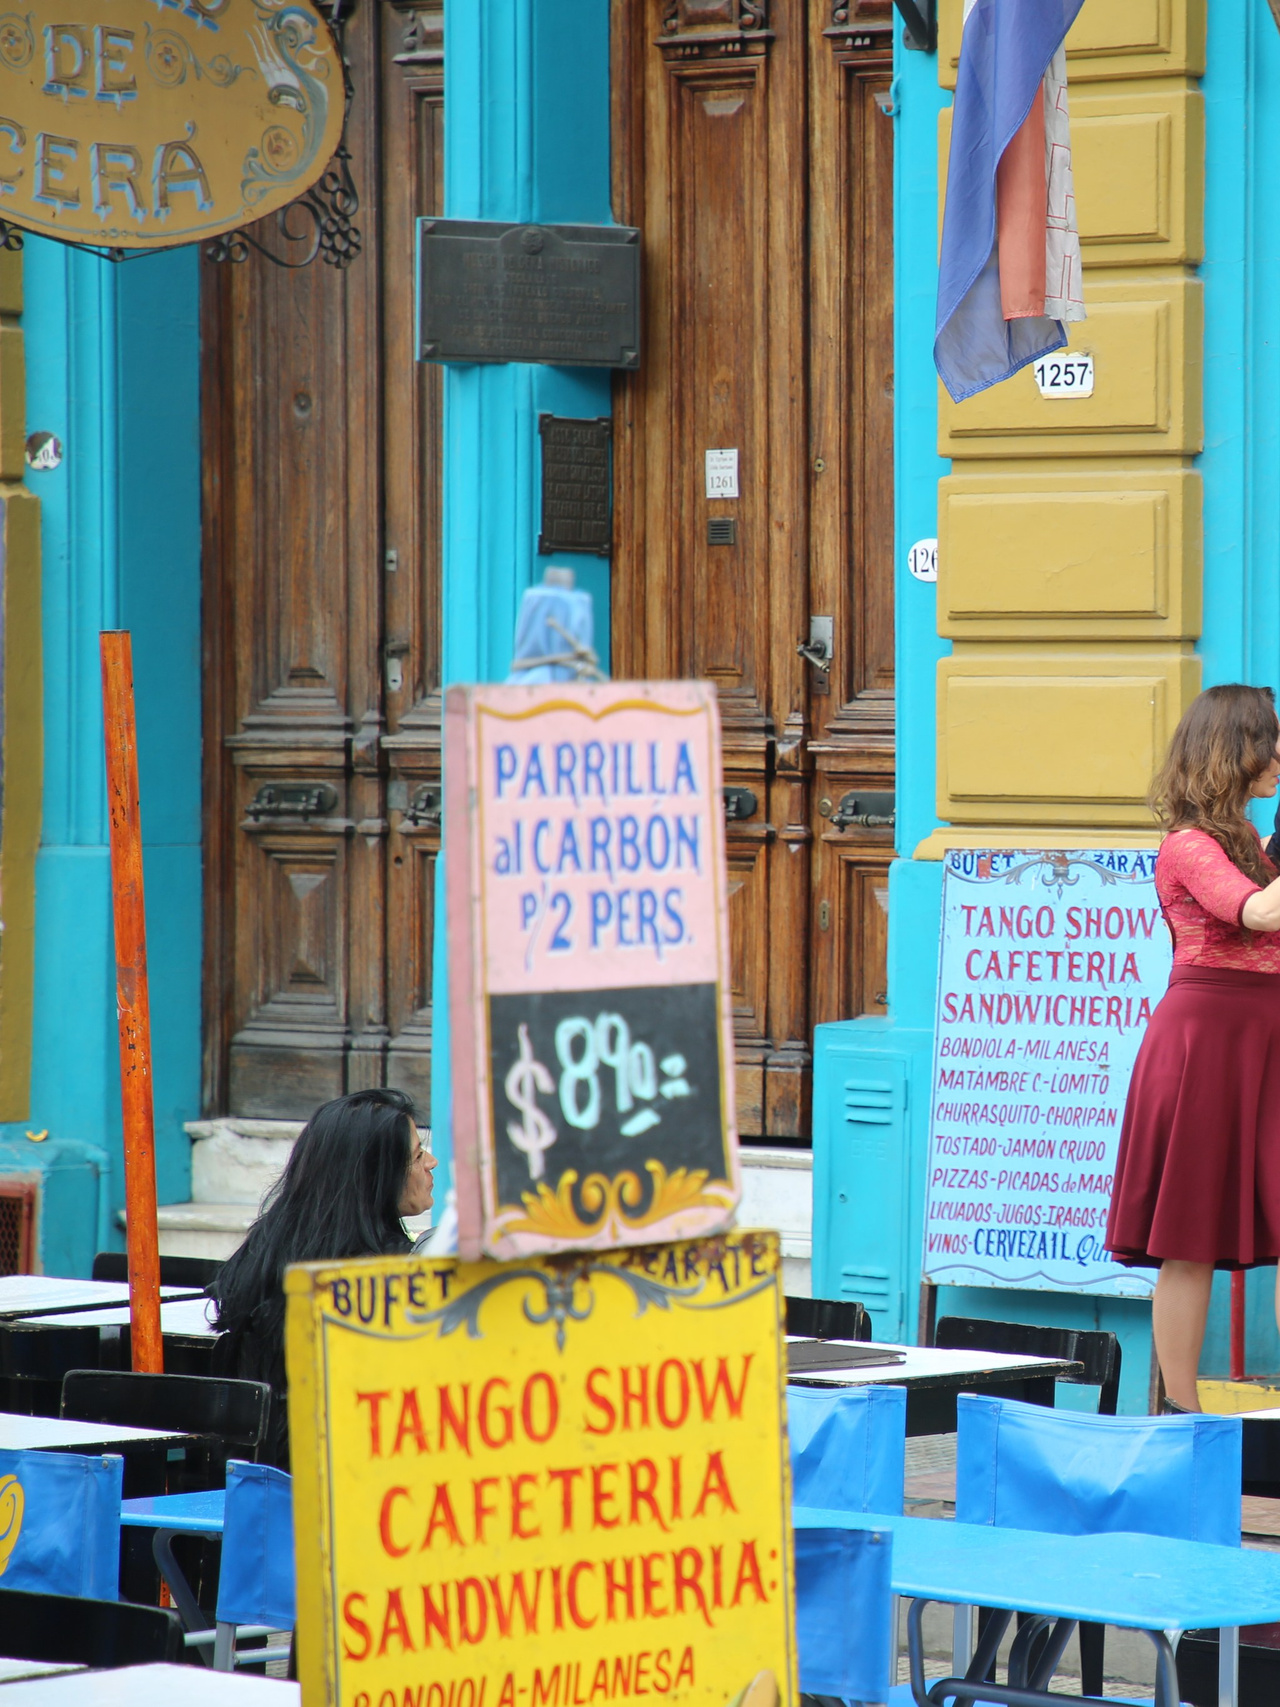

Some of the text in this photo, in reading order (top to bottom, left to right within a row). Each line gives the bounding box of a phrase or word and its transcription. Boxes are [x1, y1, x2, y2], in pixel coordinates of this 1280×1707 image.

[43, 24, 137, 111] DE
[1037, 362, 1089, 388] 1257
[710, 475, 733, 489] 1261
[494, 739, 697, 808] PARRILLA
[494, 820, 522, 874] al
[950, 852, 1015, 878] BUFET
[961, 905, 1159, 942] TANGO SHOW
[965, 949, 1142, 991] CAFETERIA
[942, 993, 1152, 1036] SANDWICHERIA
[938, 1068, 1031, 1095] MATAMBRE
[1058, 1140, 1106, 1163] CRUDO
[1061, 1173, 1077, 1193] de
[1076, 1234, 1113, 1267] Qui
[331, 1264, 455, 1327] BUFET
[356, 1354, 755, 1460] TANGO SHOW
[377, 1450, 740, 1559] CAFETERIA
